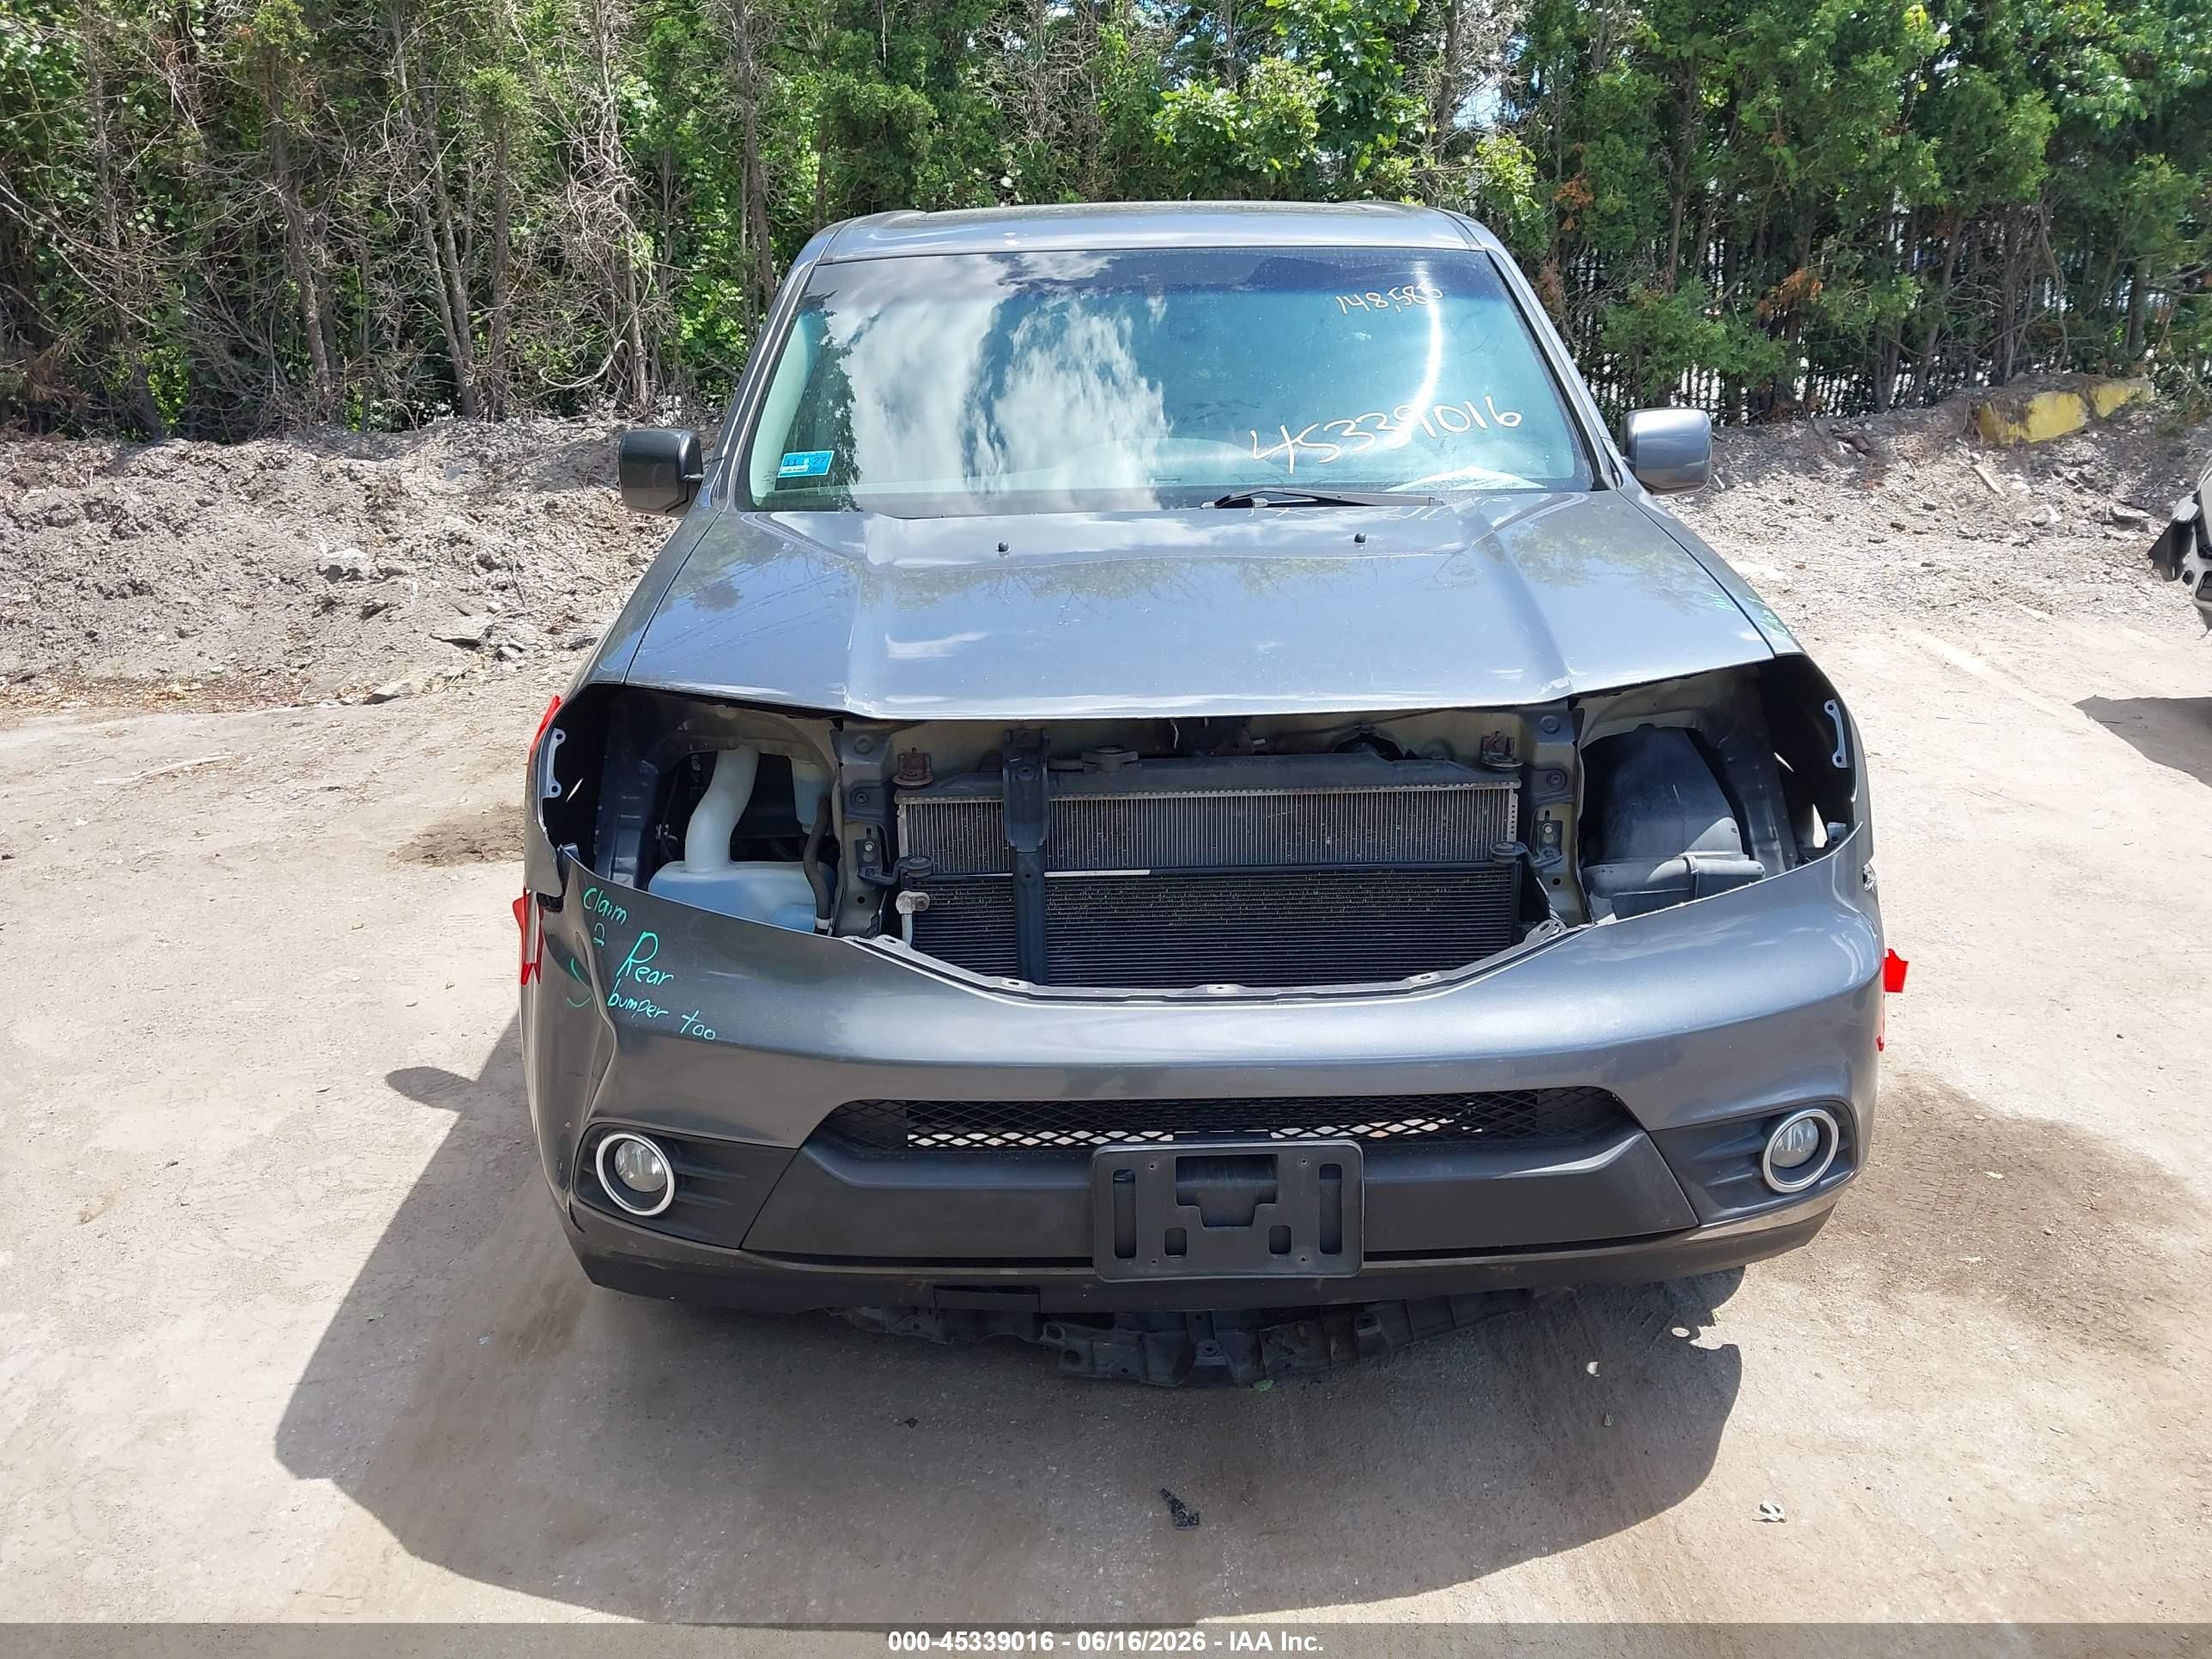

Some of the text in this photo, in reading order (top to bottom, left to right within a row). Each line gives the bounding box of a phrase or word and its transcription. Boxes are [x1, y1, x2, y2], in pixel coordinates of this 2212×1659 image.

[1250, 395, 1522, 475] 45339016
[583, 887, 628, 926] Claim
[616, 931, 673, 986] Rear
[607, 979, 716, 1041] bumper too
